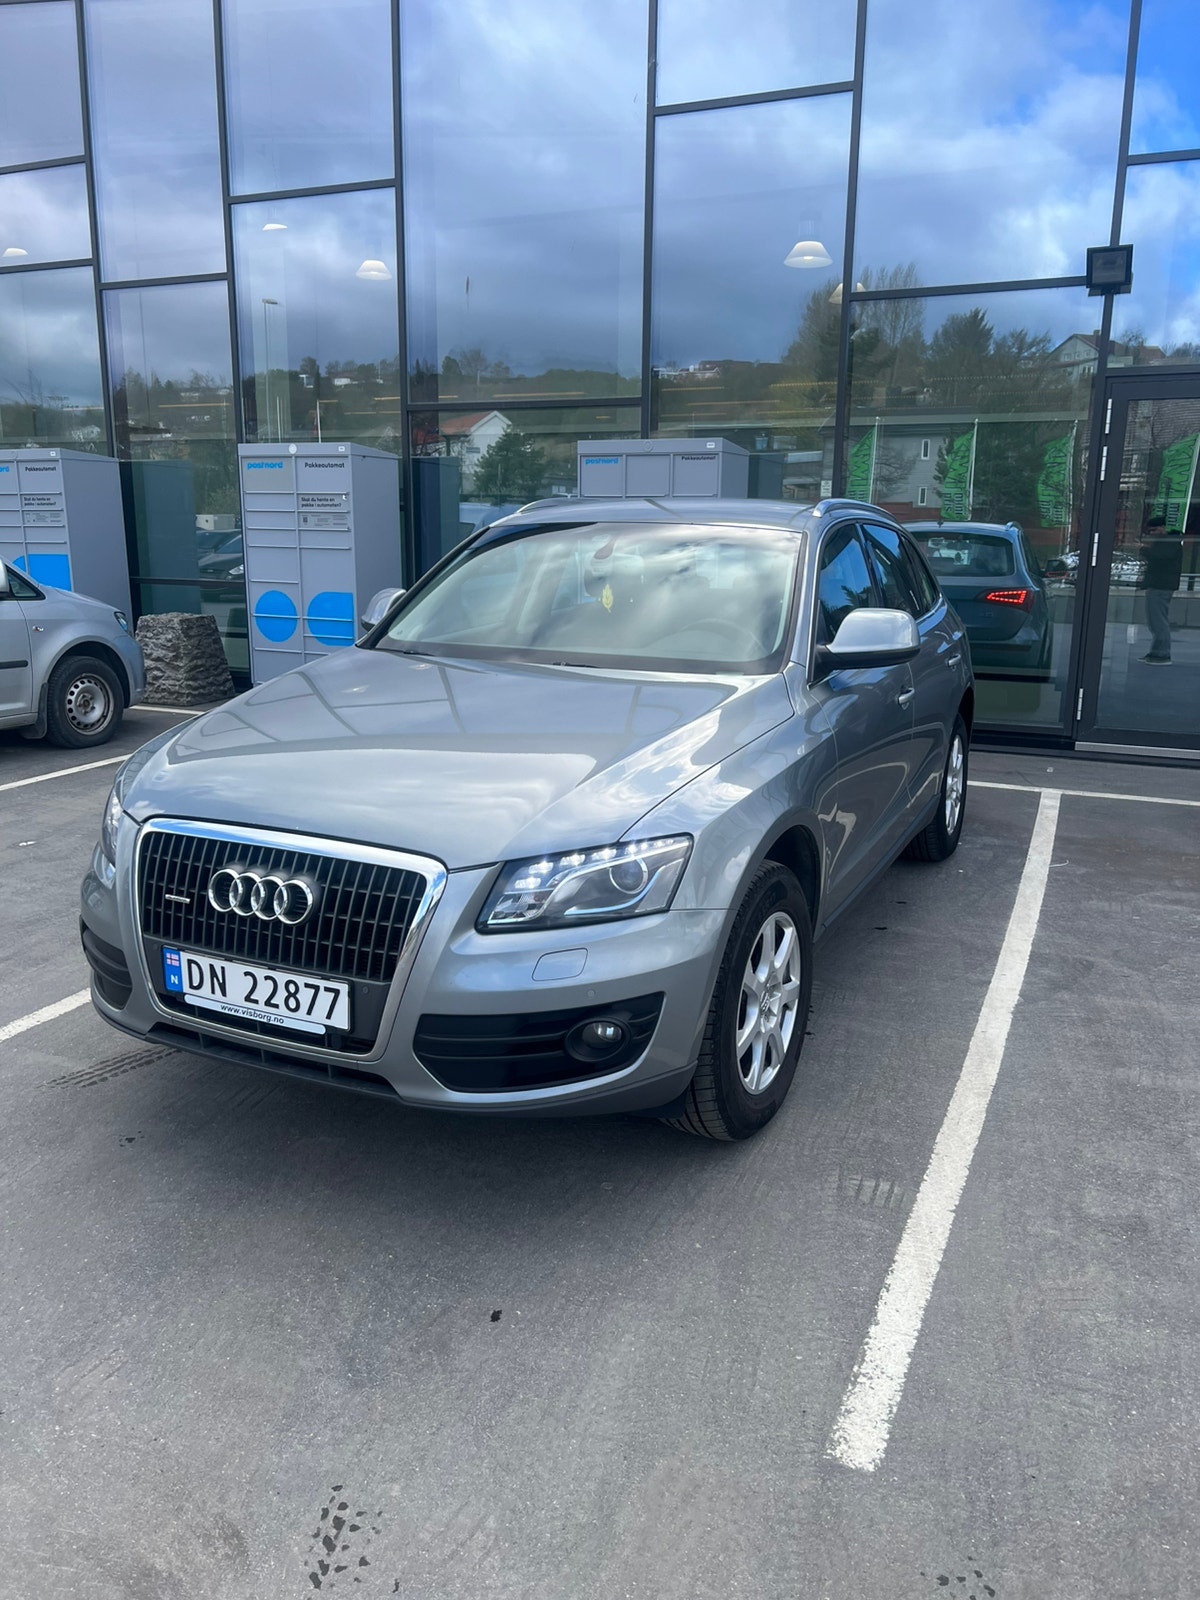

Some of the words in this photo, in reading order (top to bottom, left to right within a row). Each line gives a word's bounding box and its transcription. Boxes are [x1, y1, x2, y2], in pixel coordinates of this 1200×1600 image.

[247, 462, 283, 470] postnord
[170, 974, 179, 985] N
[186, 958, 227, 998] DN
[243, 971, 341, 1020] 22877
[220, 1004, 285, 1023] www.visborg.no
